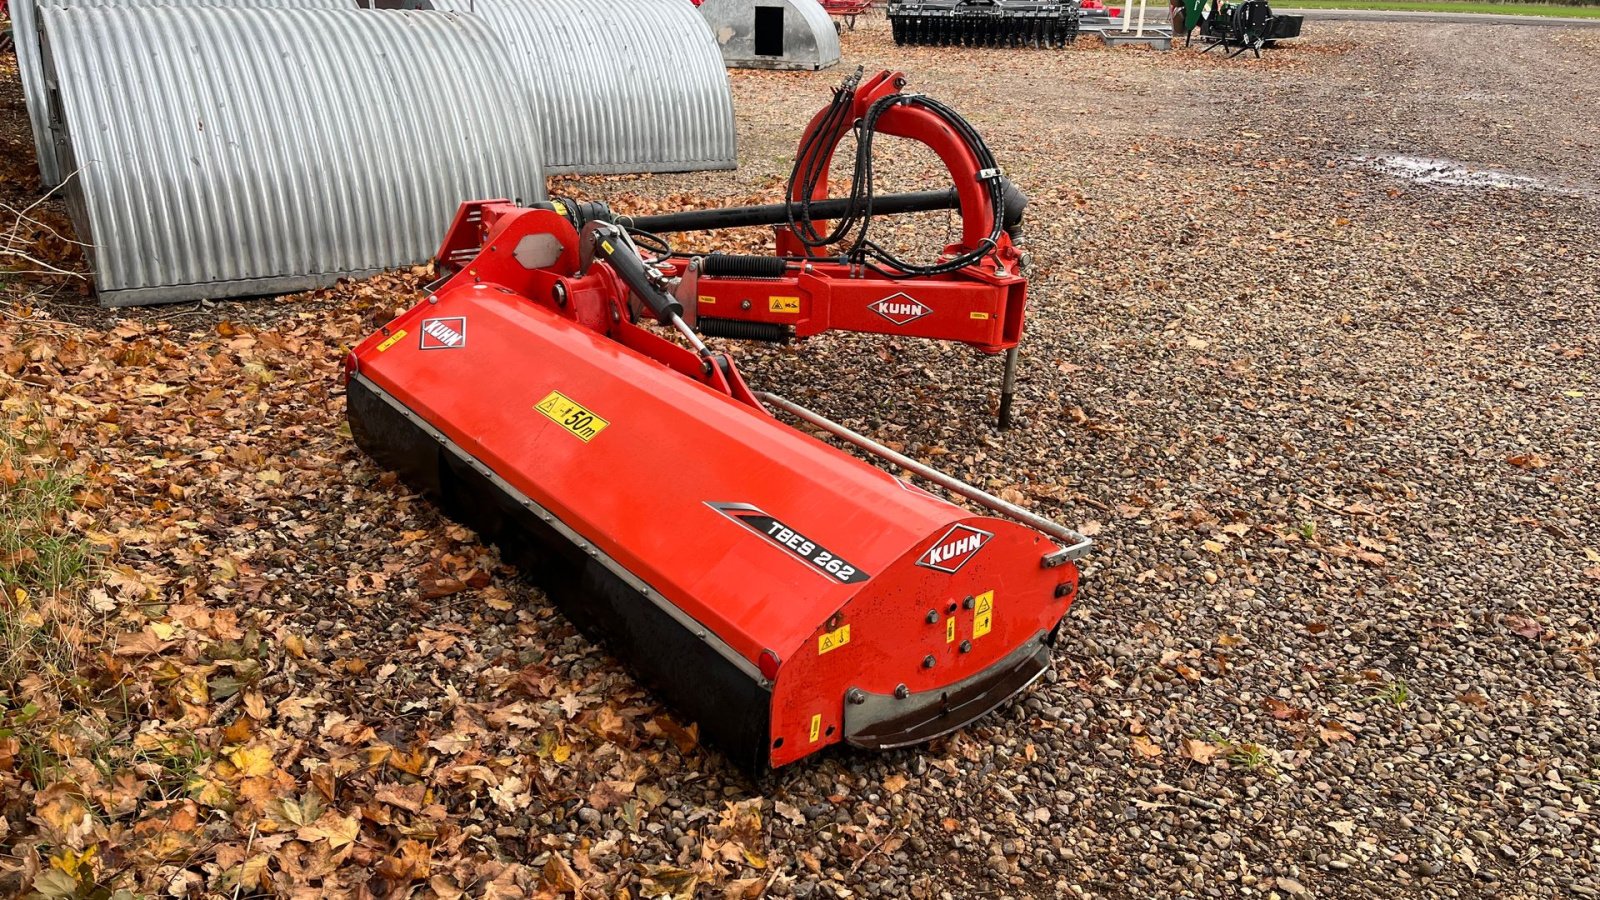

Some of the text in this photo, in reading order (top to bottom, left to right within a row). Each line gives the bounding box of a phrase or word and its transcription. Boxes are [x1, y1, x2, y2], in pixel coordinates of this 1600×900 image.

[878, 302, 922, 316] KUHN
[424, 320, 462, 346] KUHN
[768, 521, 856, 581] TBES 262
[930, 533, 981, 564] KUHN
